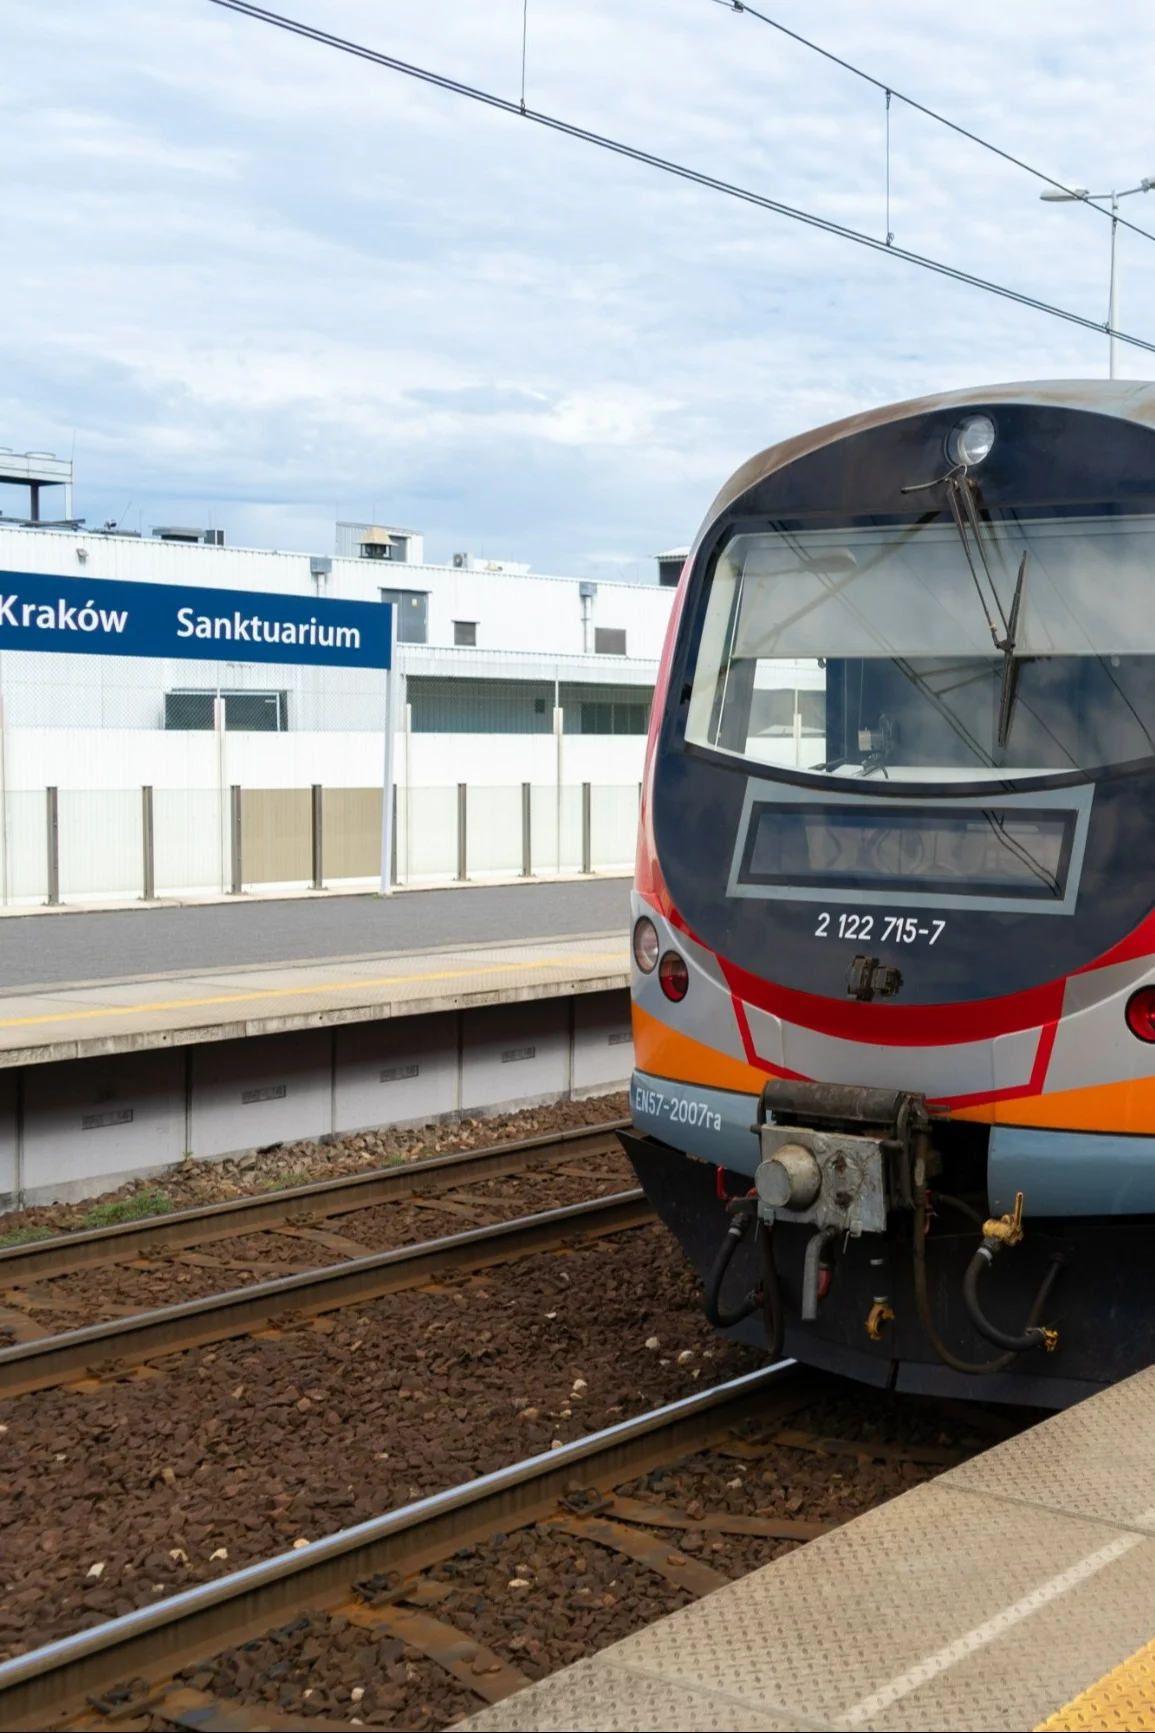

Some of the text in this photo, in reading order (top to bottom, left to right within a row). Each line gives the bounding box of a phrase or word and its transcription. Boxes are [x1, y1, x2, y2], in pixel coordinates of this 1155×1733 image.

[0, 594, 361, 648] Kraków Sanktuarium
[814, 912, 946, 945] 2 122 715-7
[635, 1087, 722, 1132] EN57-2007ra
